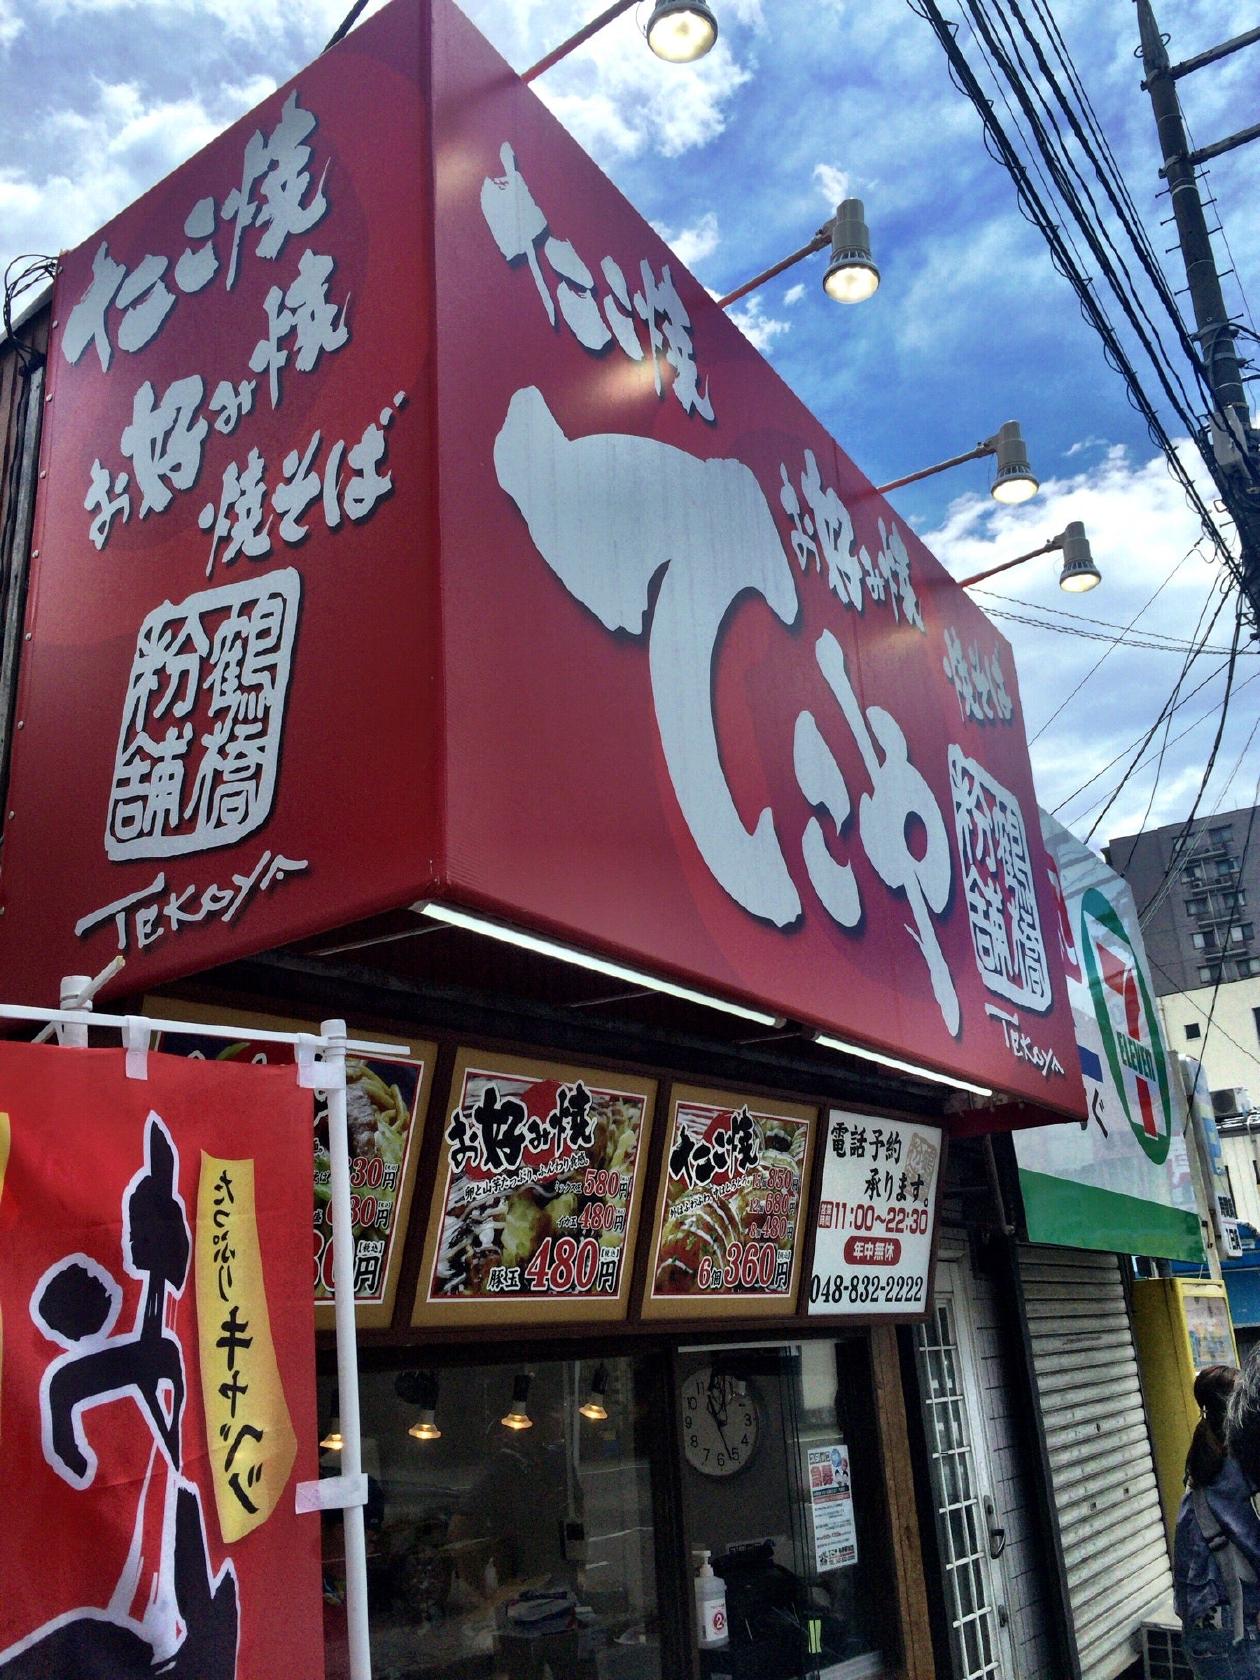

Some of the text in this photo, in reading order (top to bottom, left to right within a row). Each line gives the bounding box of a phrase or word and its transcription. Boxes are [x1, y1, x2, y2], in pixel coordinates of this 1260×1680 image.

[446, 1081, 597, 1173] お好み焼
[669, 1104, 760, 1189] たこ焼
[831, 1122, 902, 1165] 電話予約
[864, 1168, 929, 1207] 承ります。
[525, 1236, 617, 1293] 480円
[723, 1241, 790, 1289] 360円
[853, 1241, 895, 1262] 年中無休
[810, 1274, 924, 1304] 048-832-2222
